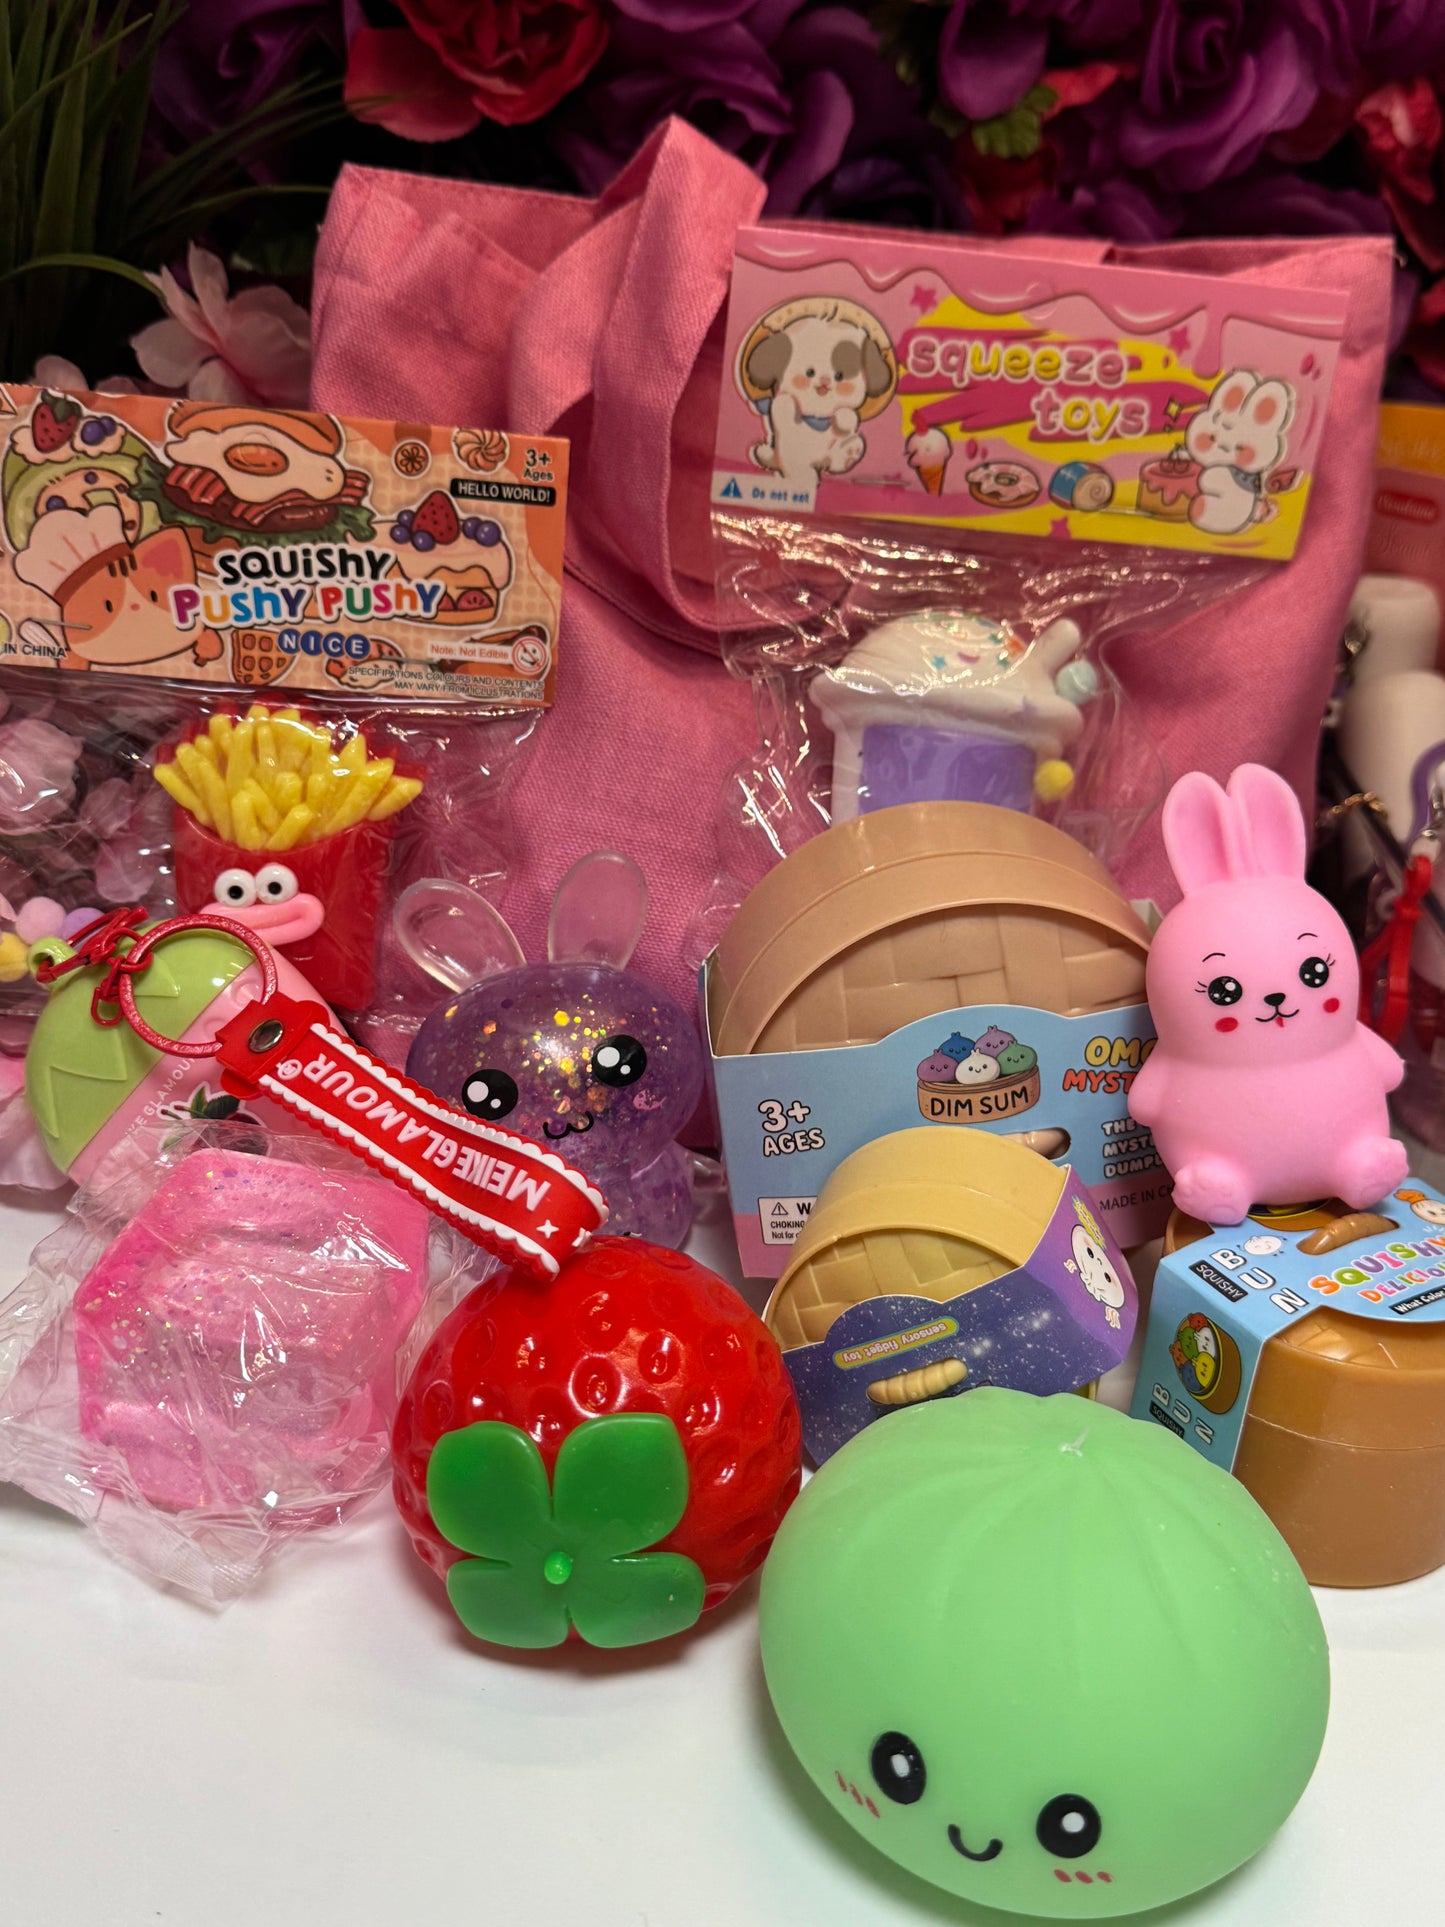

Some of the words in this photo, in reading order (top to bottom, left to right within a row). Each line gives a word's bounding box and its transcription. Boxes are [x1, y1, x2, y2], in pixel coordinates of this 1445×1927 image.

[909, 335, 1126, 388] squeeze
[1032, 391, 1150, 444] toys
[526, 449, 551, 467] 3+
[523, 468, 553, 482] Ages
[458, 482, 499, 498] HELLO
[501, 486, 551, 503] WORLD!
[752, 487, 765, 499] Do
[770, 489, 787, 501] not
[3, 643, 18, 655] IN
[21, 644, 67, 658] CHINA
[281, 631, 366, 656] NICE
[431, 644, 458, 656] Note:
[460, 646, 476, 657] Not
[480, 648, 509, 660] Edible
[394, 681, 414, 690] MAY
[417, 683, 440, 693] VARY
[443, 684, 470, 696] FROM
[472, 675, 493, 686] AND
[495, 676, 544, 689] CONTENTS
[931, 1096, 973, 1118] DIM
[980, 1086, 1030, 1114] SUM
[758, 1099, 812, 1133] 3+
[1101, 1117, 1137, 1137] THE
[762, 1127, 826, 1158] AGES
[1099, 1193, 1137, 1211] MADE
[1141, 1189, 1155, 1203] IN
[771, 1231, 784, 1240] Not
[785, 1231, 795, 1239] for
[1195, 1263, 1243, 1299] SQUISHY
[1395, 1297, 1422, 1314] What
[1420, 1287, 1442, 1303] Color
[900, 1321, 948, 1347] sensory
[842, 1348, 863, 1363] toy
[862, 1337, 900, 1358] fidget
